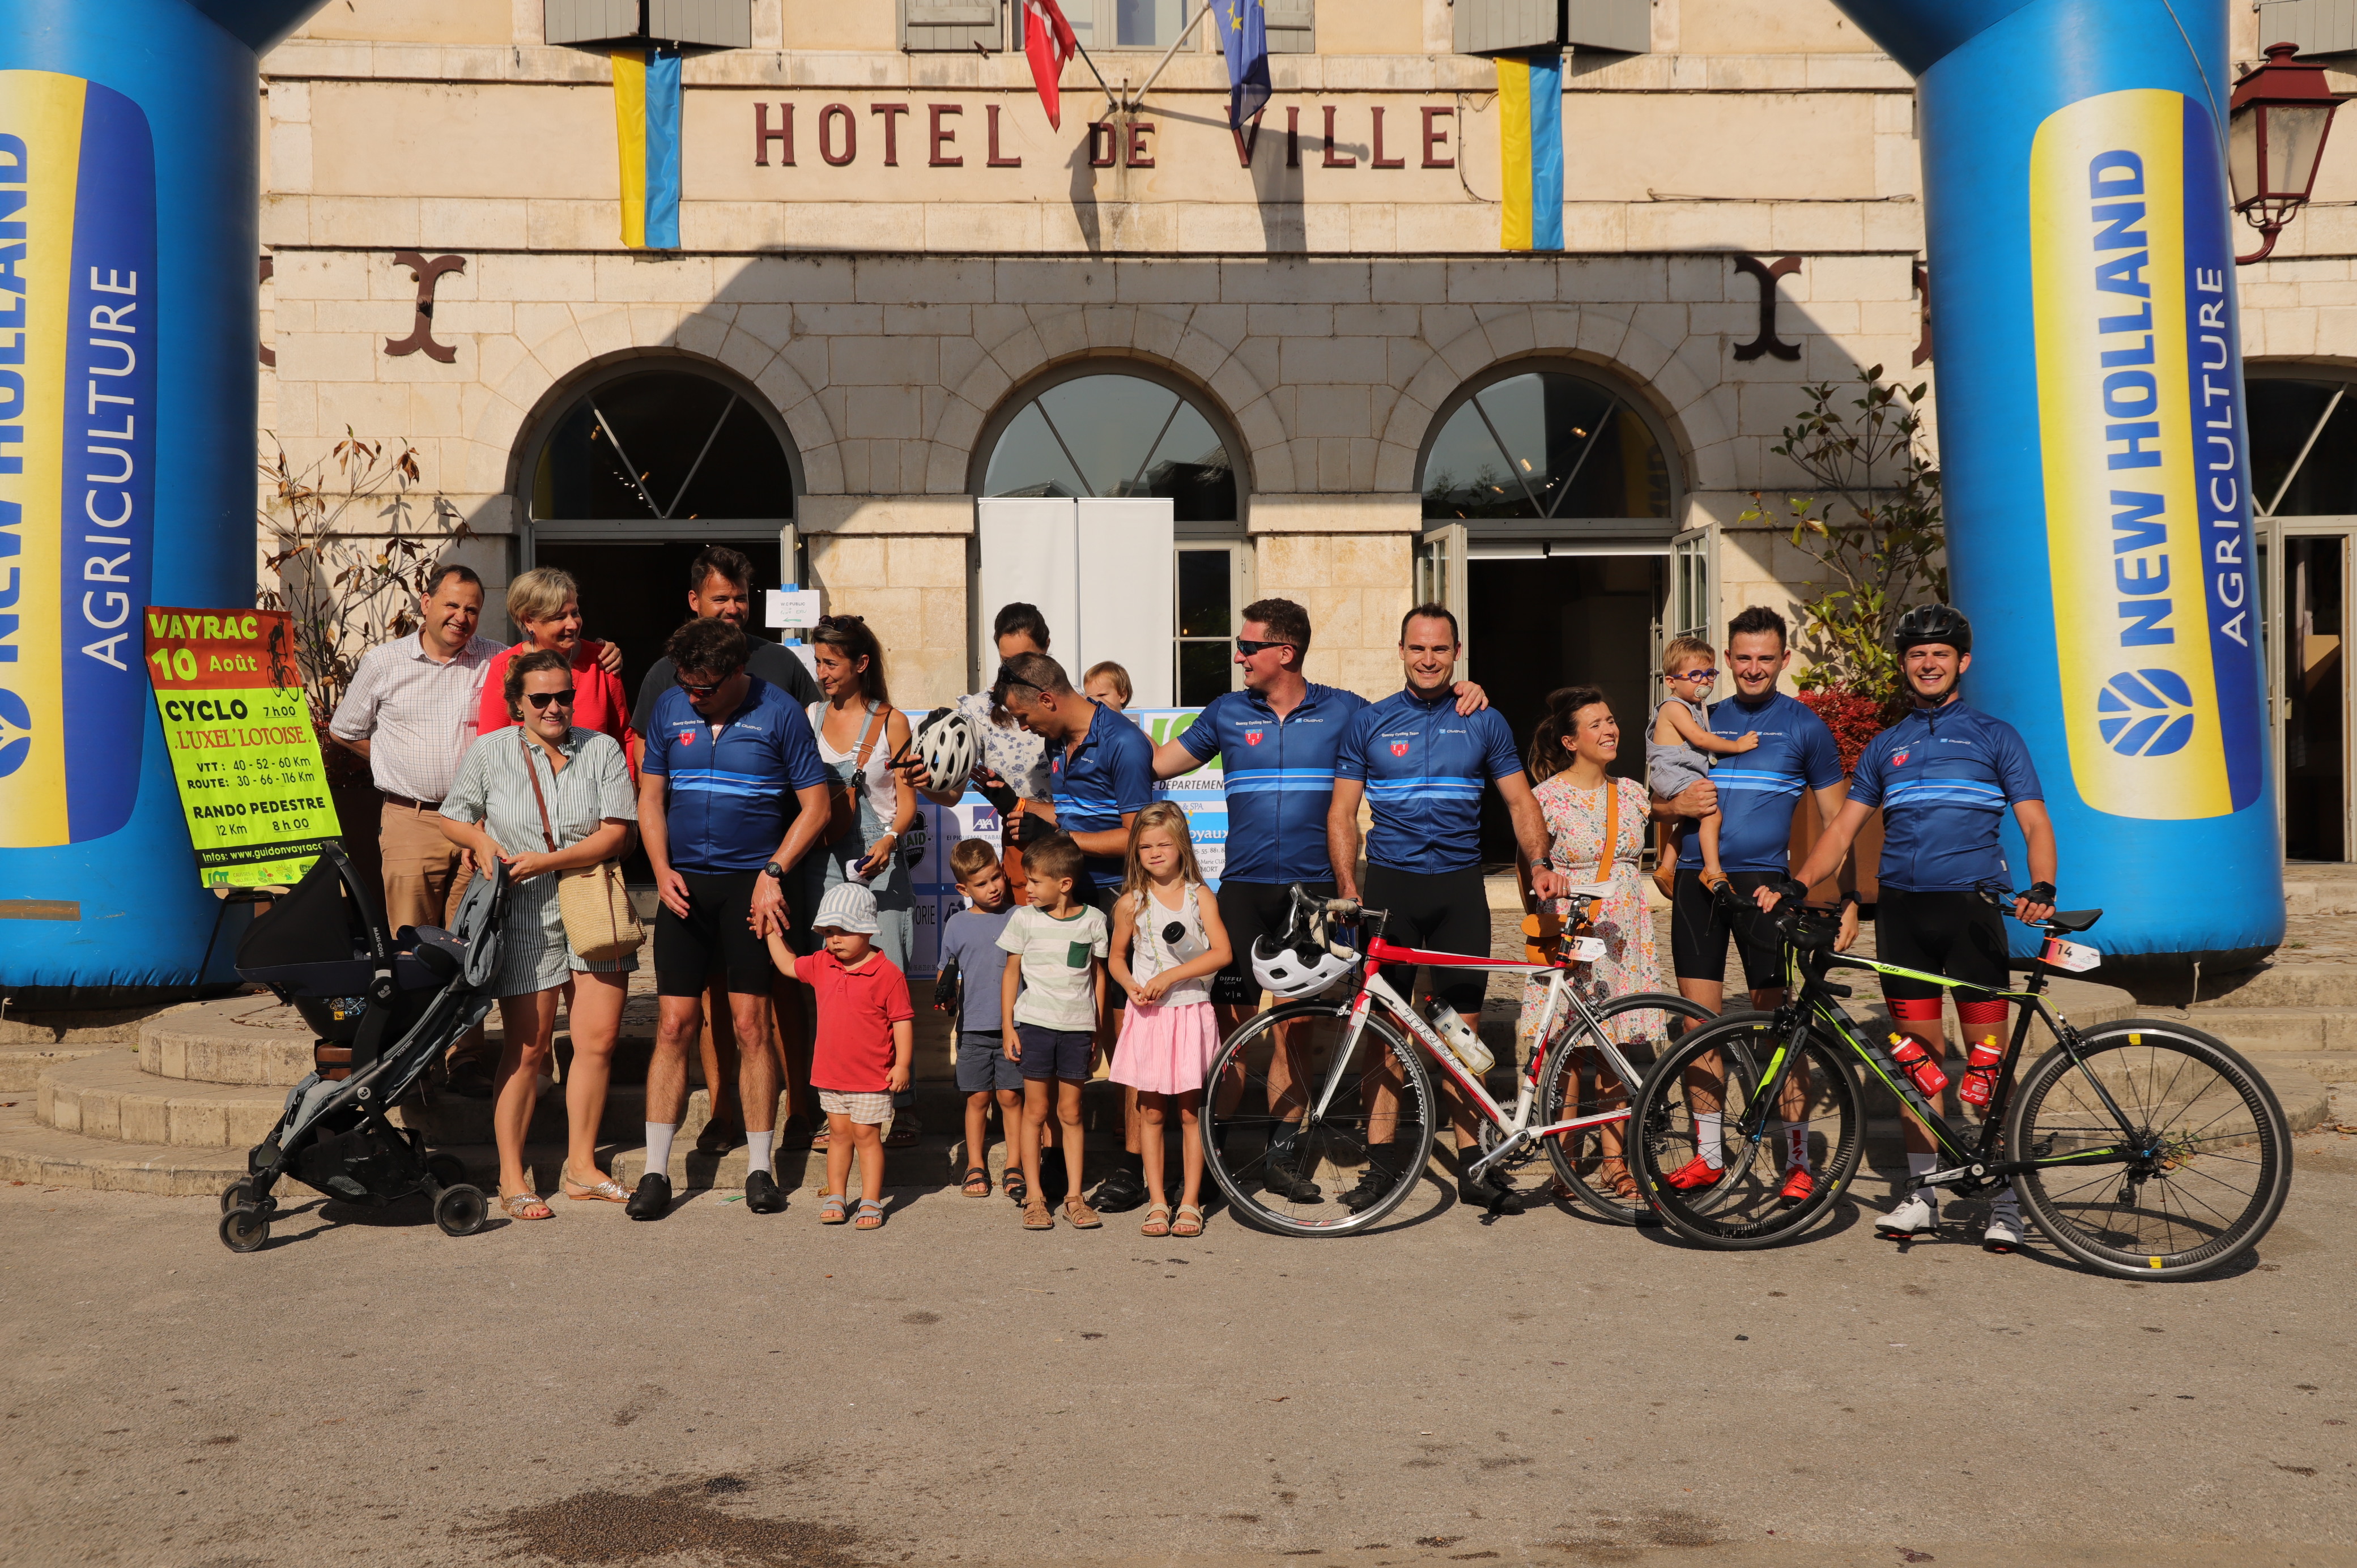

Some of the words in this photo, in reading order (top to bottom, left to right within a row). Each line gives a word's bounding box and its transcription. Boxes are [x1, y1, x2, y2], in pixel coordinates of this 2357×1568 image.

[753, 103, 1021, 167] HOTEL
[1088, 122, 1155, 168] DE
[1224, 105, 1455, 168] VILLE
[2089, 149, 2162, 470] HOLLAND
[82, 266, 137, 671] AGRICULTURE
[2196, 267, 2248, 647] AGRICULTURE
[2109, 489, 2175, 647] NEW
[148, 613, 258, 640] VAYRAC
[151, 648, 198, 681] 10
[210, 654, 258, 672] Août
[165, 699, 248, 722] CYCLO
[233, 760, 246, 770] 40
[257, 759, 269, 769] 52
[279, 757, 291, 768] 60
[292, 756, 311, 767] Km
[186, 778, 229, 789] ROUTE:
[237, 775, 250, 787] 30
[260, 774, 273, 785] 66
[282, 772, 296, 783] 116
[297, 772, 315, 782] Km
[193, 803, 246, 819] RANDO
[249, 796, 326, 815] PEDESTRE
[1190, 802, 1204, 811] SPA
[216, 825, 227, 836] 12
[229, 824, 248, 835] Km
[973, 819, 995, 829] AXA
[1189, 829, 1228, 842] oyaux
[202, 852, 228, 862] Infos:
[372, 927, 385, 957] MAXI-COSI
[2058, 943, 2073, 958] 14
[1403, 1008, 1465, 1071] TREK
[1787, 1029, 1805, 1065] LOOK
[1397, 1038, 1422, 1074] BONTRAGER
[1394, 1045, 1425, 1126] BONTRAGER
[1550, 1033, 1582, 1111] BONTRAGER
